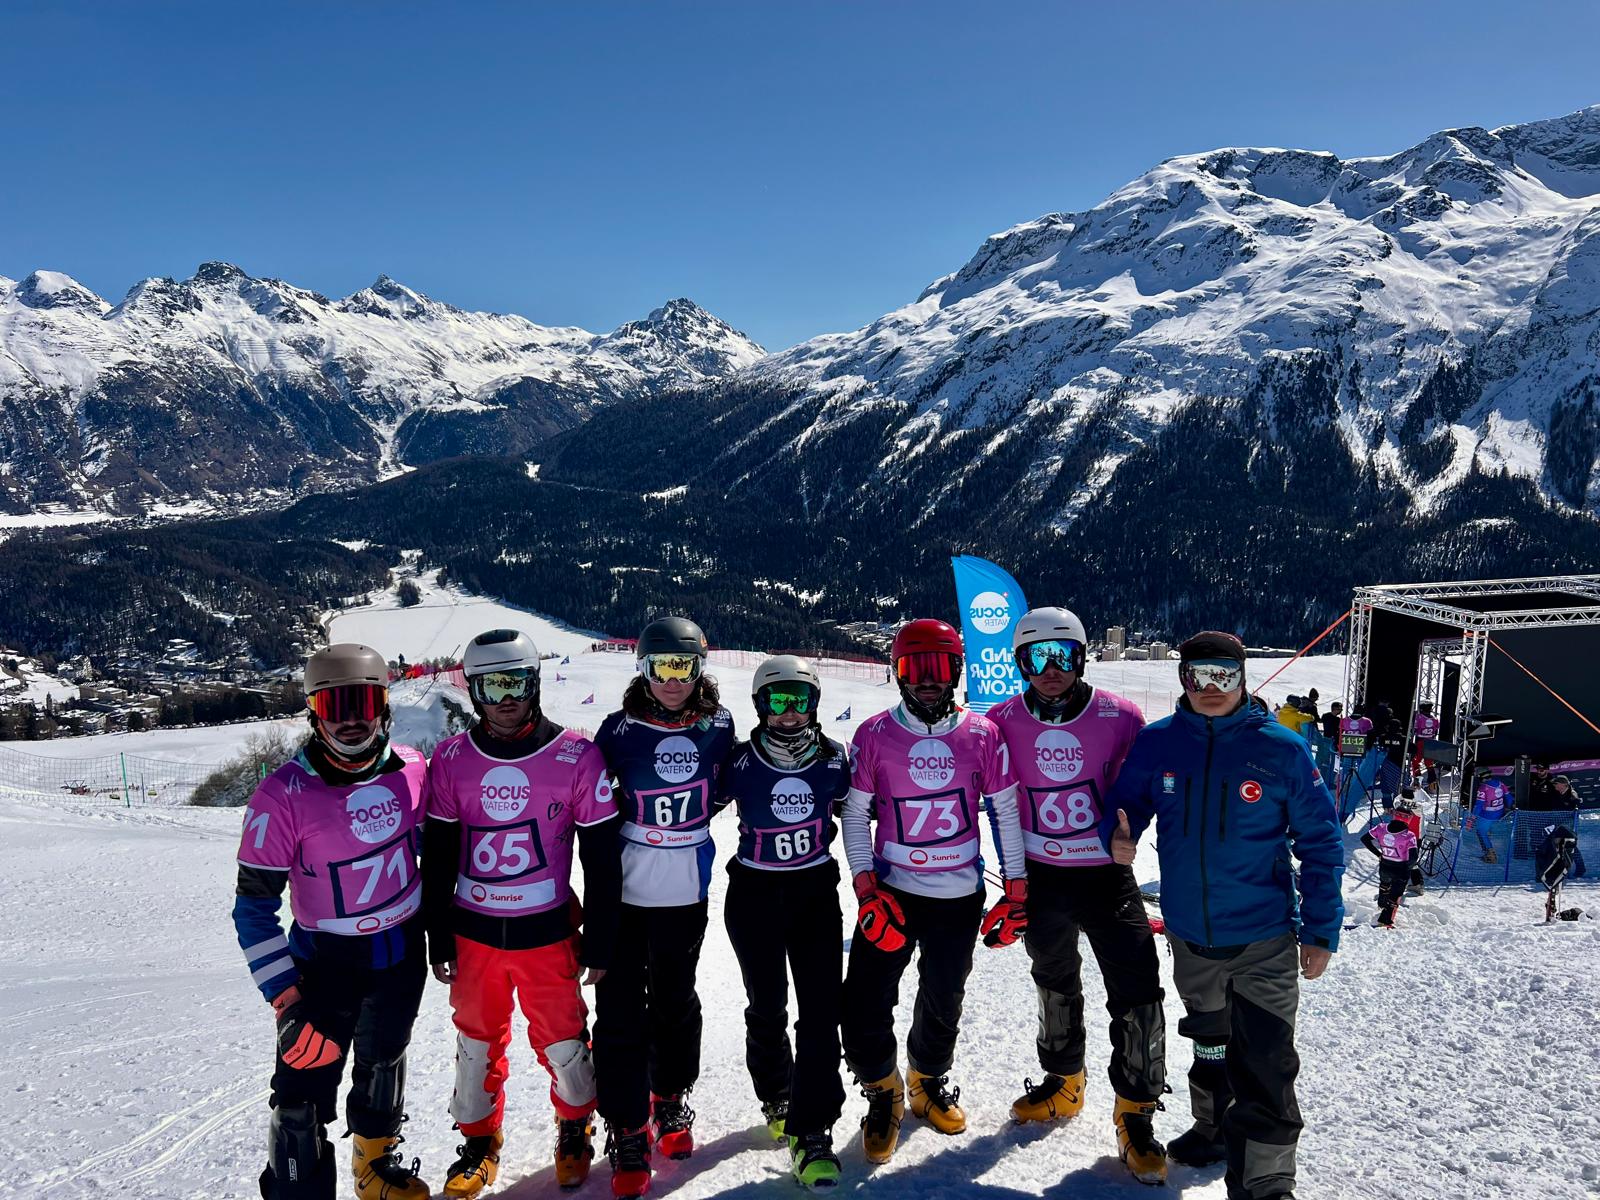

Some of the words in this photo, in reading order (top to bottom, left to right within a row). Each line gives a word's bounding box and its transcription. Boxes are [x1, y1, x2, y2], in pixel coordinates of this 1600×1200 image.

[656, 752, 699, 764] FOCUS
[850, 743, 860, 774] 3
[908, 756, 955, 770] FOCUS
[1036, 747, 1083, 762] FOCUS
[480, 785, 530, 800] FOCUS
[771, 793, 815, 805] FOCUS
[349, 798, 401, 823] FOCUS
[654, 790, 691, 827] 67
[1039, 791, 1094, 830] 68
[905, 800, 959, 837] 73
[667, 834, 693, 842] Sunrise
[774, 829, 810, 861] 66
[472, 832, 530, 875] 65
[931, 852, 961, 862] Sunrise
[1066, 844, 1099, 854] Sunrise
[351, 846, 409, 904] 71
[490, 892, 523, 902] Sunrise
[384, 904, 413, 924] Sunrise
